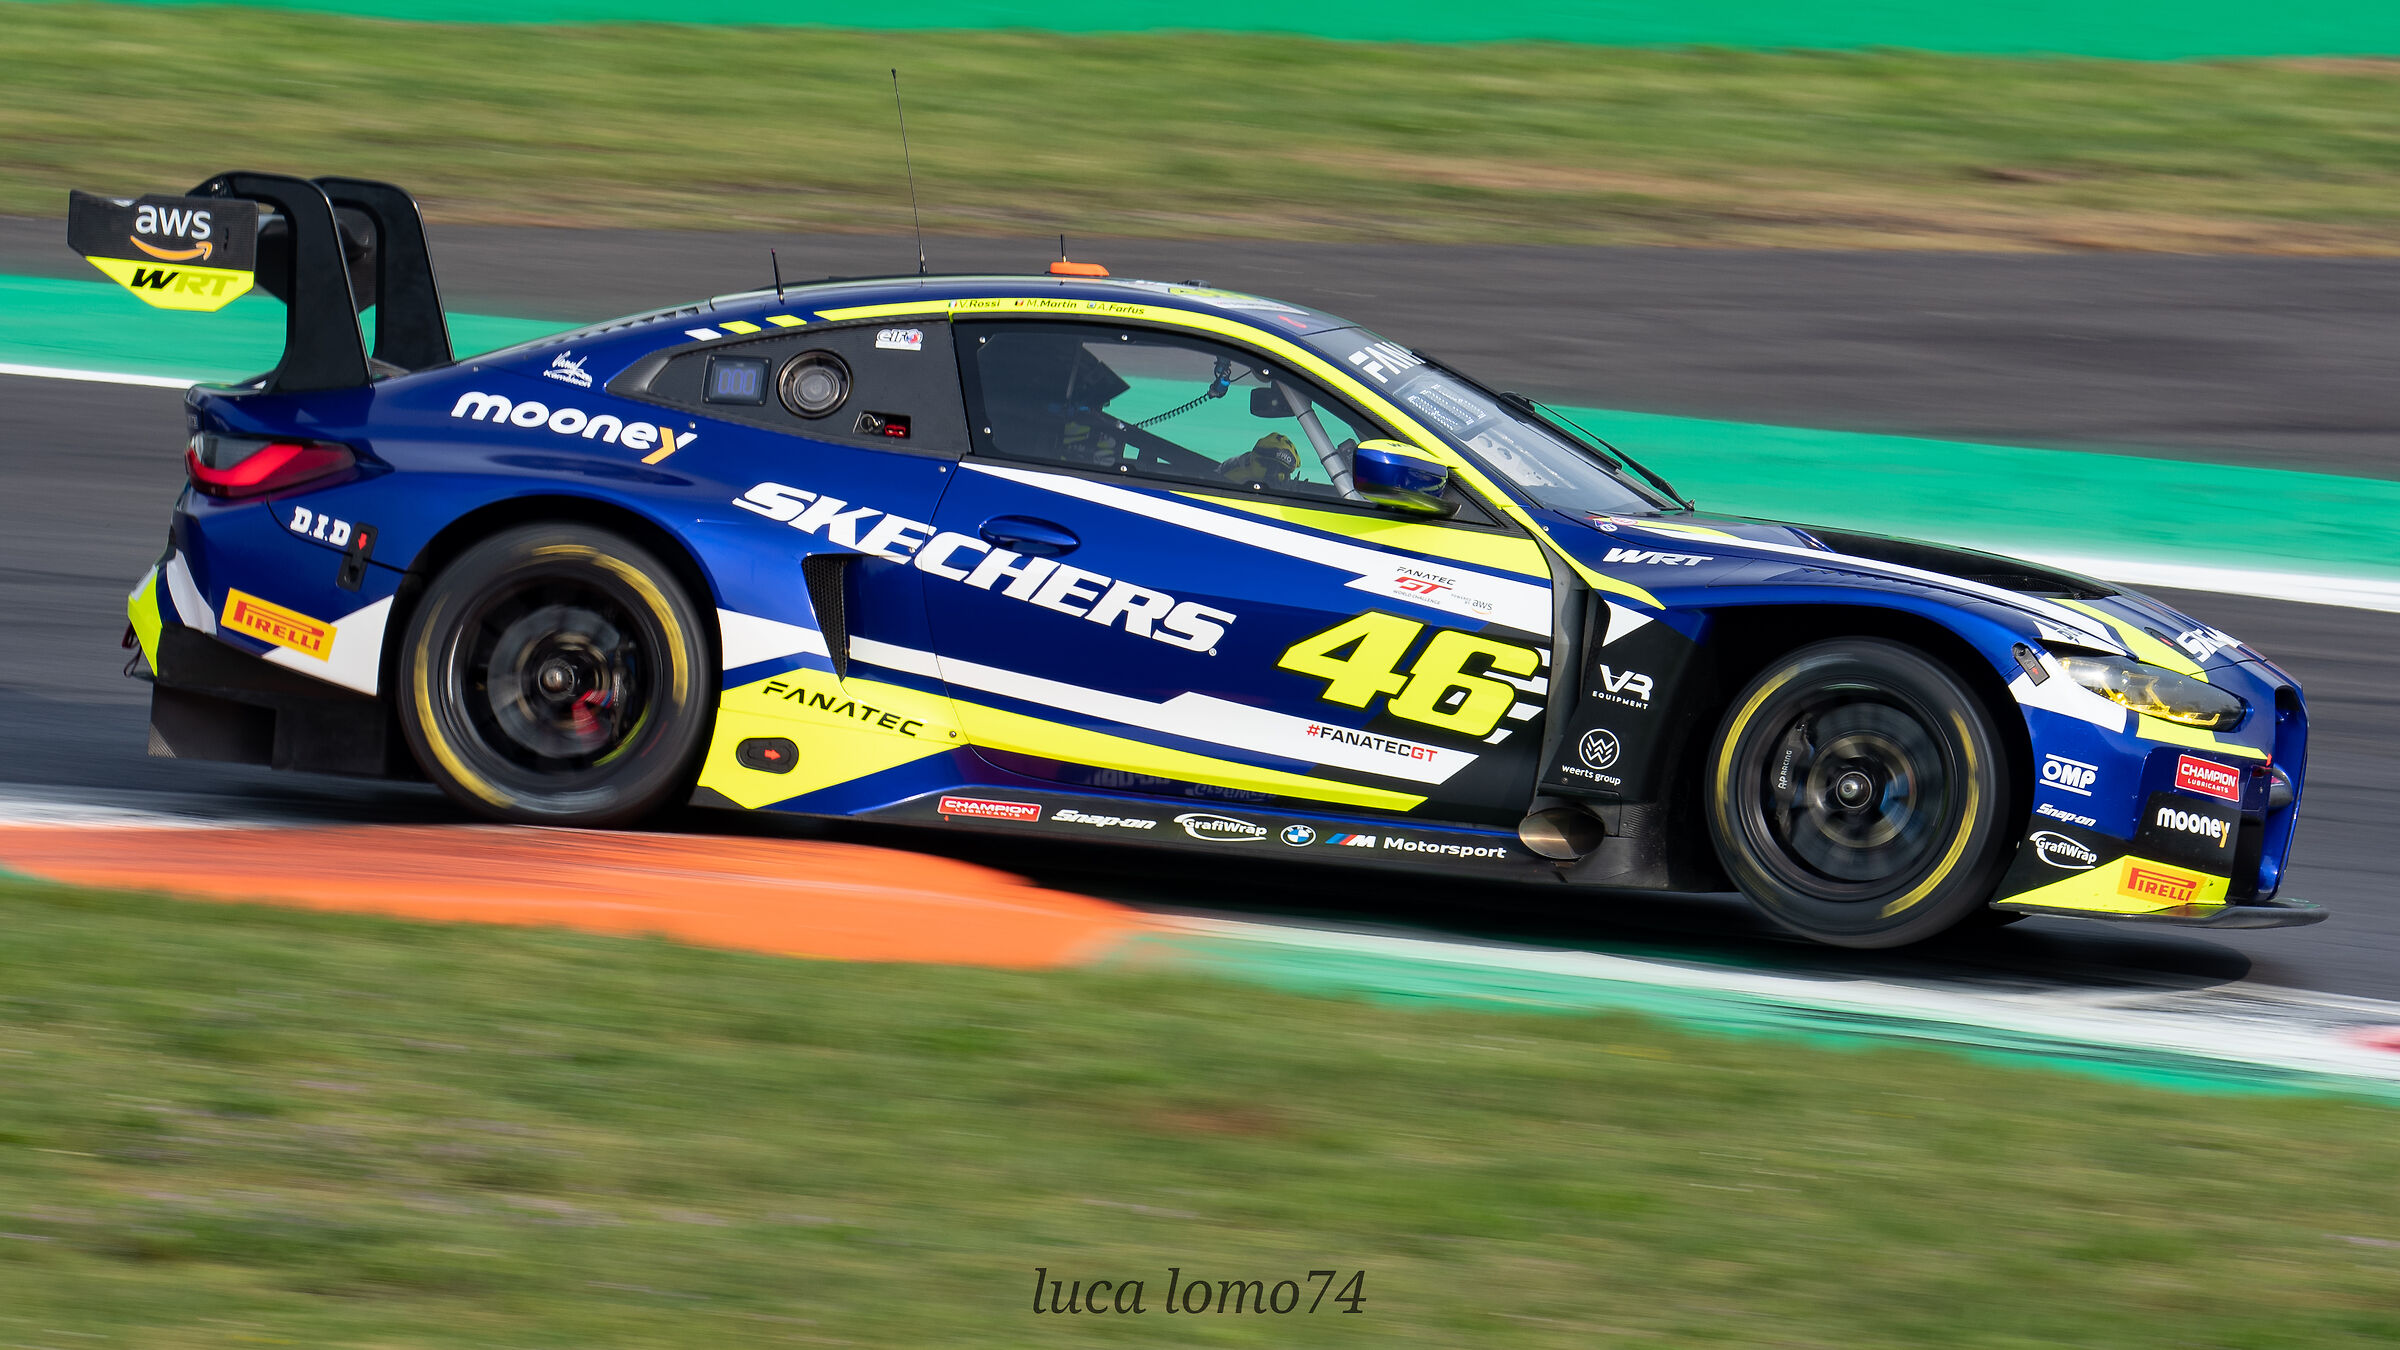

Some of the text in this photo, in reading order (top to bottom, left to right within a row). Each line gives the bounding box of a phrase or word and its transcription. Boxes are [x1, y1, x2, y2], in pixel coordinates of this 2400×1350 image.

[135, 205, 211, 240] aws
[131, 268, 239, 297] WRT
[959, 299, 1001, 308] V.Rossi
[1026, 299, 1078, 309] M.Martin
[1096, 302, 1145, 315] A.Farfus
[451, 391, 698, 465] mooney
[733, 482, 1237, 653] SKECHERS
[1602, 547, 1714, 566] WRT
[1396, 566, 1457, 586] FANATEC
[1472, 599, 1493, 611] aws
[233, 600, 325, 652] PIRELLI
[1275, 609, 1542, 738] 46
[1600, 664, 1653, 701] VR
[762, 681, 924, 737] FANATEC
[1592, 690, 1648, 710] EQUIPMENT
[1306, 724, 1438, 762] #FANATECGT
[1561, 764, 1621, 787] weerts group
[2042, 760, 2097, 789] OMP
[2180, 763, 2237, 788] CHAMPION
[2187, 778, 2229, 794] LUBRICANTS
[944, 800, 1035, 816] CHAMPION
[955, 808, 1021, 819] LUBRICANTS
[1051, 809, 1158, 830] Snap-on
[2036, 803, 2097, 827] Snap-on
[1182, 818, 1268, 837] GrafiWrap
[2156, 807, 2231, 848] mooney
[1383, 836, 1508, 858] Motorsport
[2035, 837, 2098, 865] GrafiWrap
[2128, 867, 2197, 902] PIRELLI
